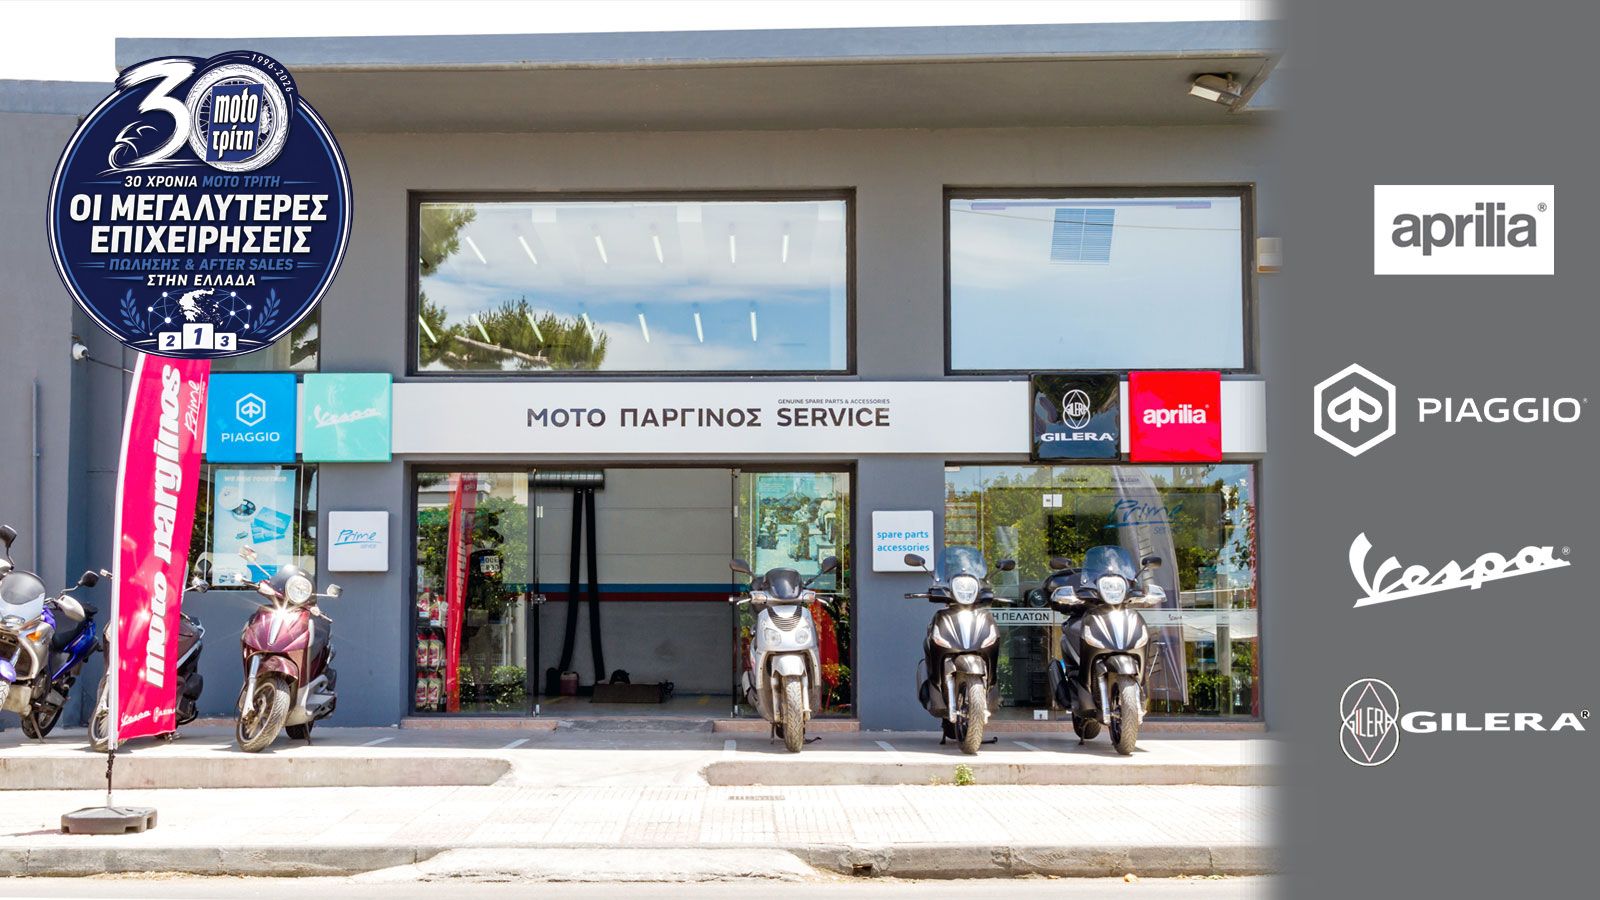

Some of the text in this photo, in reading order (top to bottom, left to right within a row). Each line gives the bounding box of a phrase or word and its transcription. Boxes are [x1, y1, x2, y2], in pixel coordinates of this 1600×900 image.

[527, 408, 890, 427] MOTO ΠΑΡΓΙΝΟΣ SERVICE
[1143, 404, 1207, 427] aprilia
[221, 432, 280, 442] PIAGGIO
[1041, 432, 1114, 441] GILERA
[1104, 499, 1184, 528] Prime
[335, 529, 379, 545] Prime
[877, 531, 929, 540] spare parts
[877, 543, 930, 551] accessories
[1002, 612, 1050, 621] ΠΕΛΑΤΩΝ
[146, 571, 168, 688] moto
